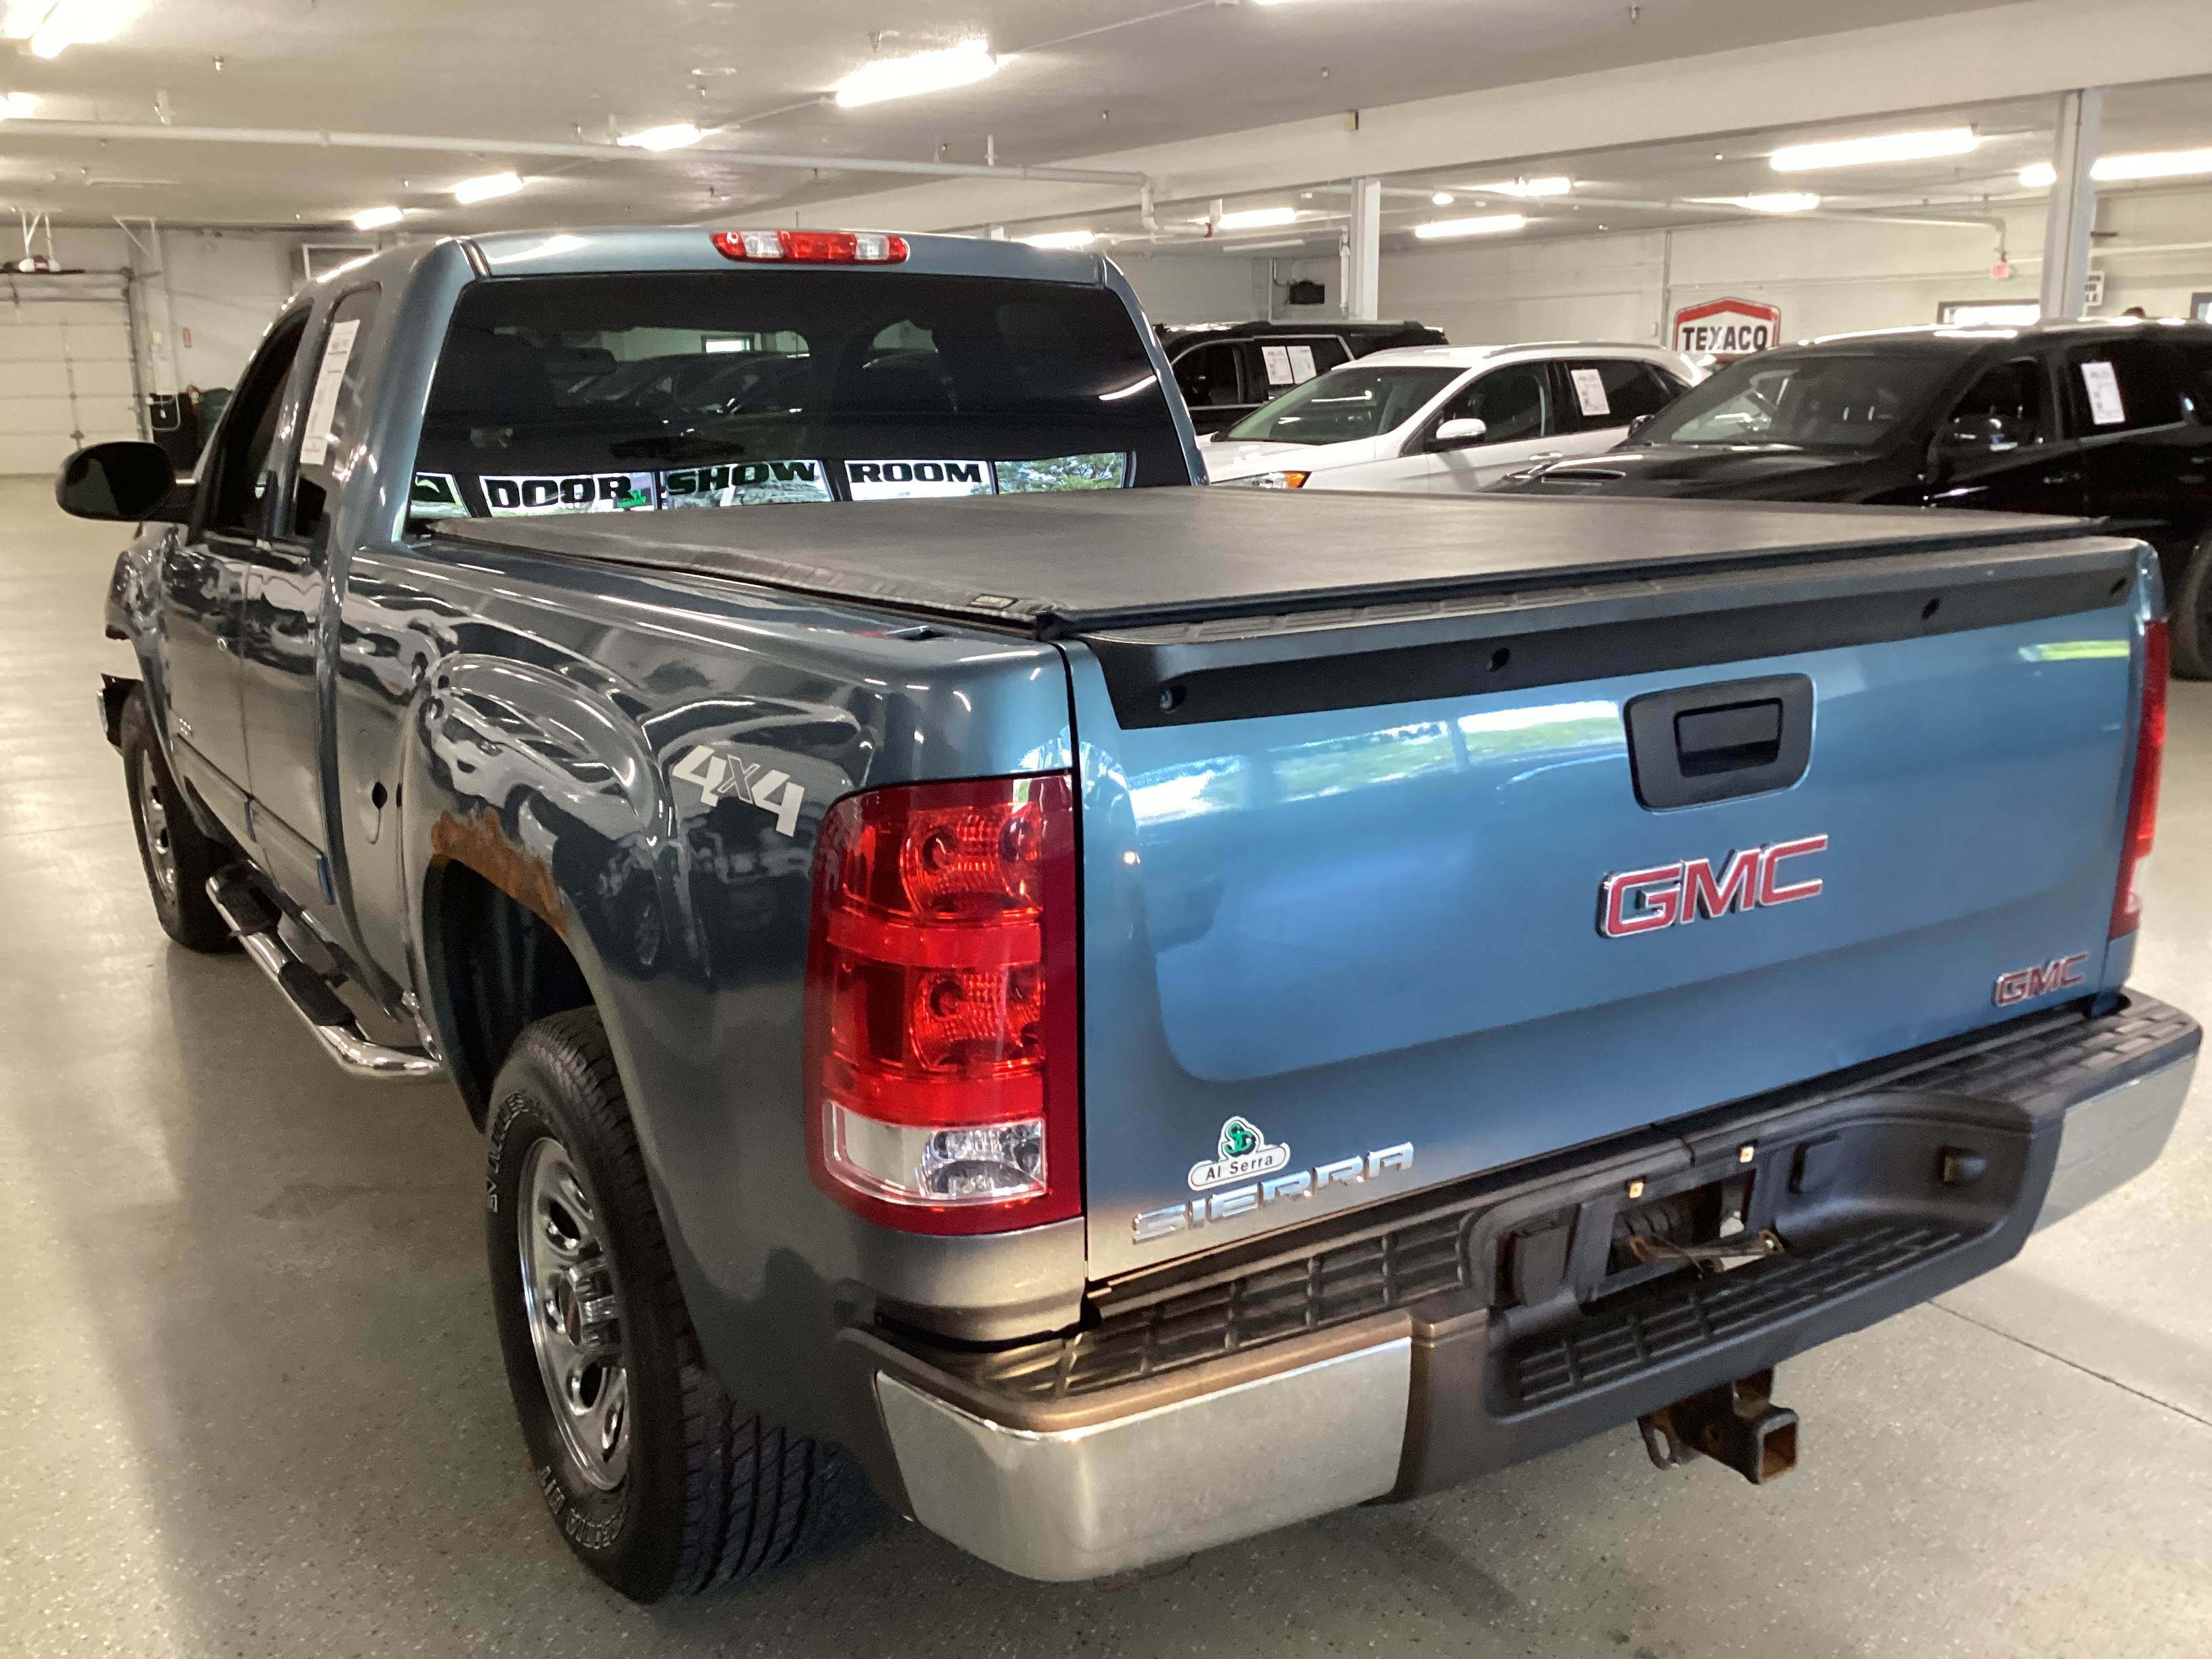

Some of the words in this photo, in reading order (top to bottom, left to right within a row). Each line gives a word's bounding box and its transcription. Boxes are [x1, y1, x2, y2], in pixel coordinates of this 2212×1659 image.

[1682, 325, 1768, 351] TEXACO
[482, 475, 635, 508] DOOR
[667, 462, 815, 495] SHOW
[846, 463, 981, 483] ROOM
[1595, 833, 1828, 938] GMC
[1991, 950, 2089, 1007] GMC
[1132, 1141, 1414, 1246] SIERRA
[1205, 1165, 1221, 1181] Al
[1229, 1155, 1273, 1175] Serra
